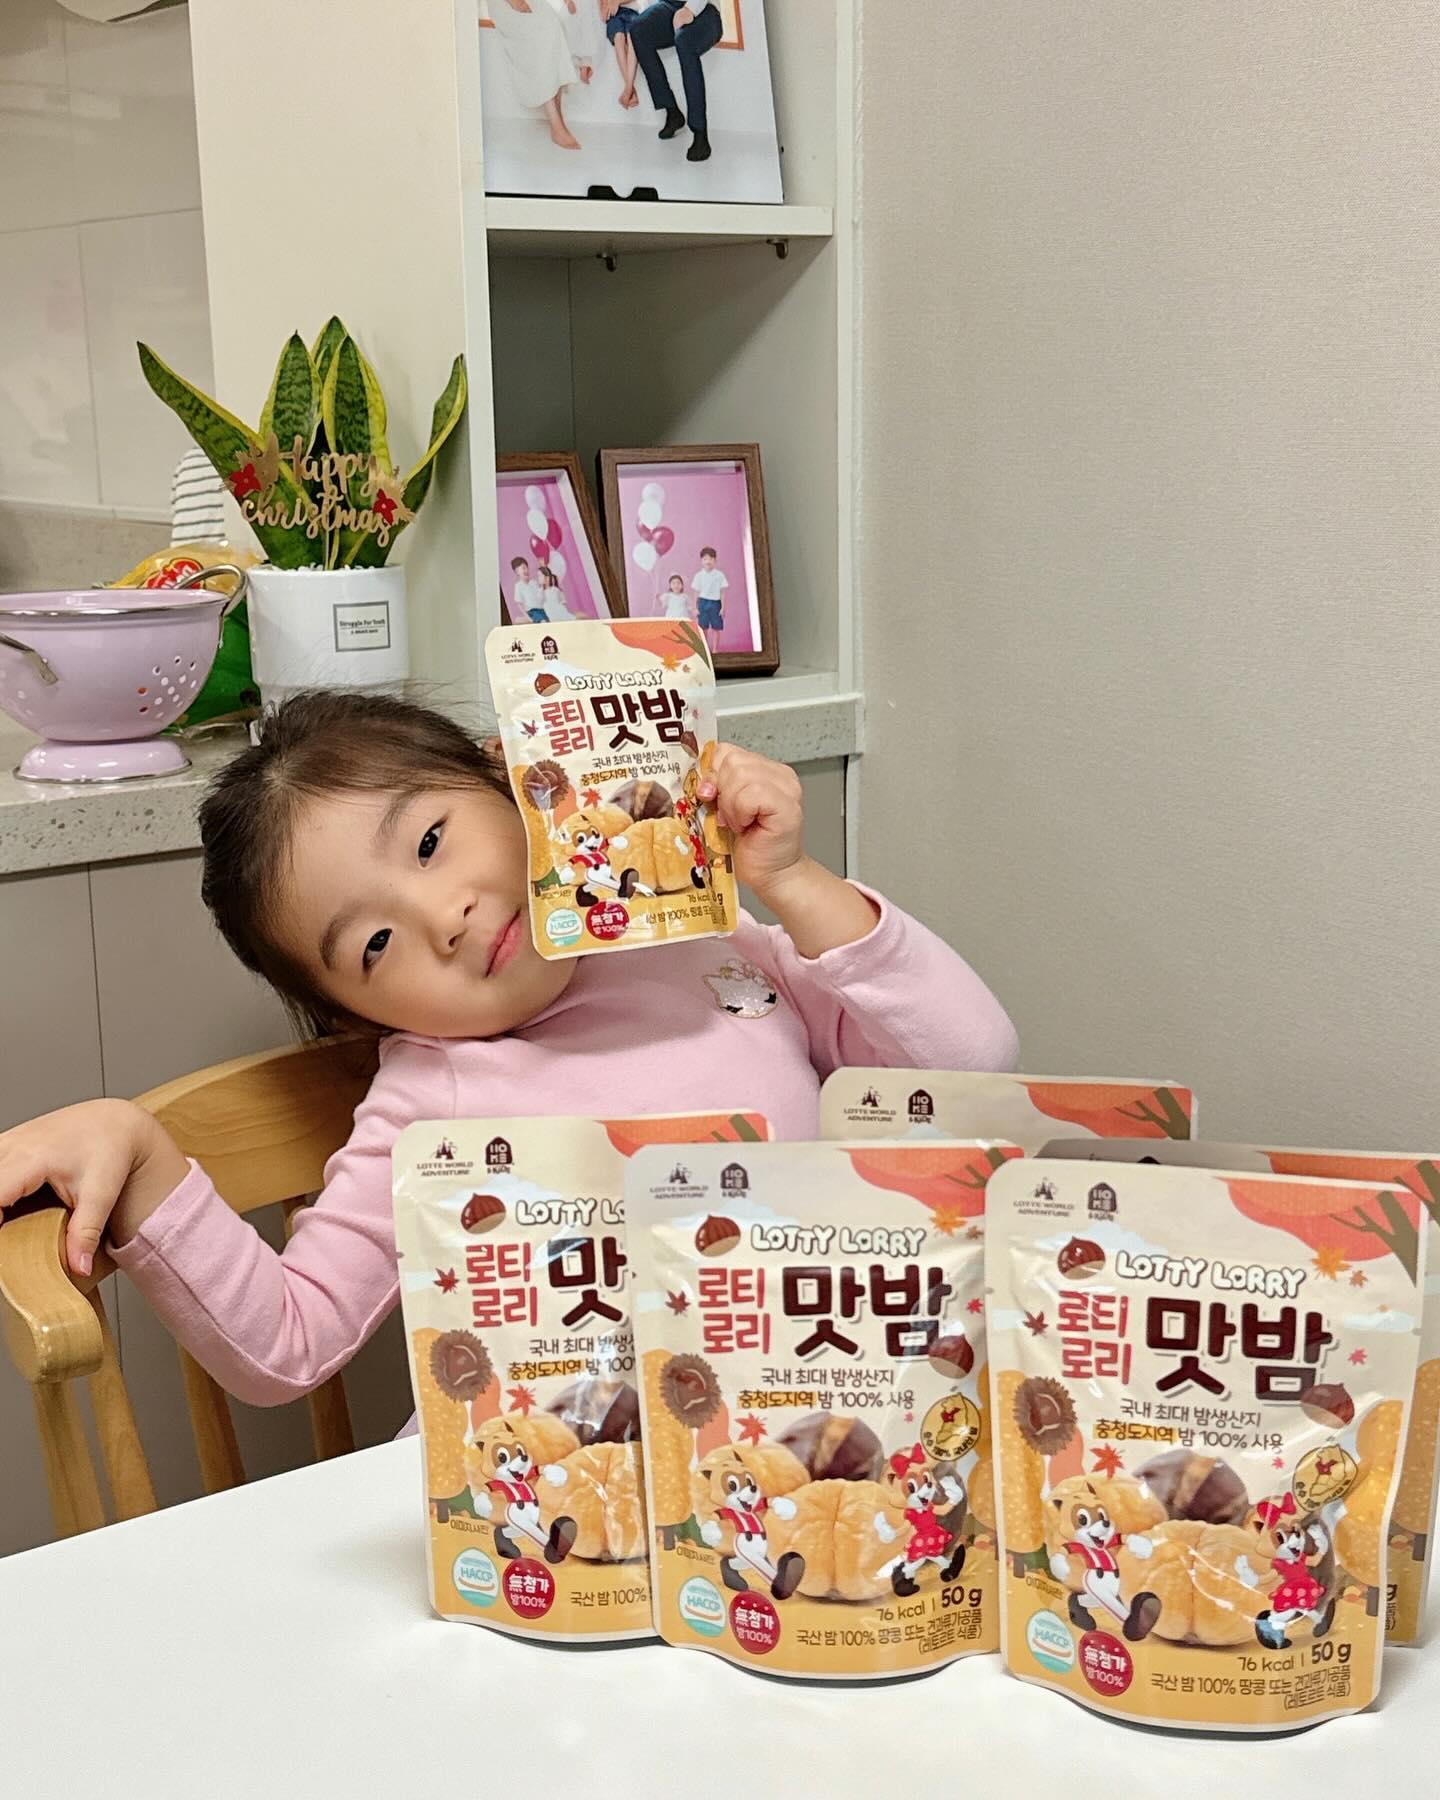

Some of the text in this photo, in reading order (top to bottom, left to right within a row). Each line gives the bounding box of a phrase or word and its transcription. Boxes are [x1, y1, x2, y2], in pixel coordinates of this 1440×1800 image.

[565, 669, 664, 691] LOTTY LORRY
[540, 699, 586, 729] 로티
[590, 688, 686, 750] 맛밤
[549, 725, 595, 757] 로리
[516, 1198, 597, 1226] LOTTY
[751, 1224, 927, 1258] LOTTY LORRY
[465, 1241, 532, 1285] 로티
[1115, 1249, 1307, 1299] LOTTY LORRY
[698, 1267, 766, 1309] 로티
[472, 1286, 539, 1329] 로리
[782, 1264, 953, 1358] 맛밤
[1057, 1290, 1129, 1338] 로티
[529, 1338, 559, 1357] 국내
[563, 1337, 594, 1354] 최대
[702, 1313, 770, 1355] 로리
[1146, 1296, 1334, 1402] 맛밤
[508, 1356, 635, 1380] 충청도지역 밤 100
[1061, 1337, 1132, 1385] 로리
[761, 1368, 895, 1388] 국내 최대 밤생산지
[738, 1389, 915, 1410] 충청도지역 밤 100% 사용
[1120, 1397, 1261, 1430] 국내 최대 밤생산지
[1096, 1419, 1285, 1454] 충청도지역 밤 100% 사용
[460, 1566, 493, 1581] HACCP
[570, 1587, 647, 1607] 국산 밤 100%
[876, 1585, 983, 1621] 76 kcal 50 g
[796, 1629, 822, 1646] 국산
[824, 1629, 838, 1646] 밤
[840, 1630, 876, 1646] 100%
[878, 1627, 902, 1645] 땅콩
[904, 1624, 926, 1641] 또는
[1237, 1641, 1352, 1672] 76 kcal 50 g
[1151, 1673, 1178, 1691] 국산
[1181, 1676, 1195, 1692] 밤
[1197, 1677, 1236, 1695] 100%
[1239, 1678, 1266, 1696] 땅콩
[1269, 1678, 1293, 1695] 또는
